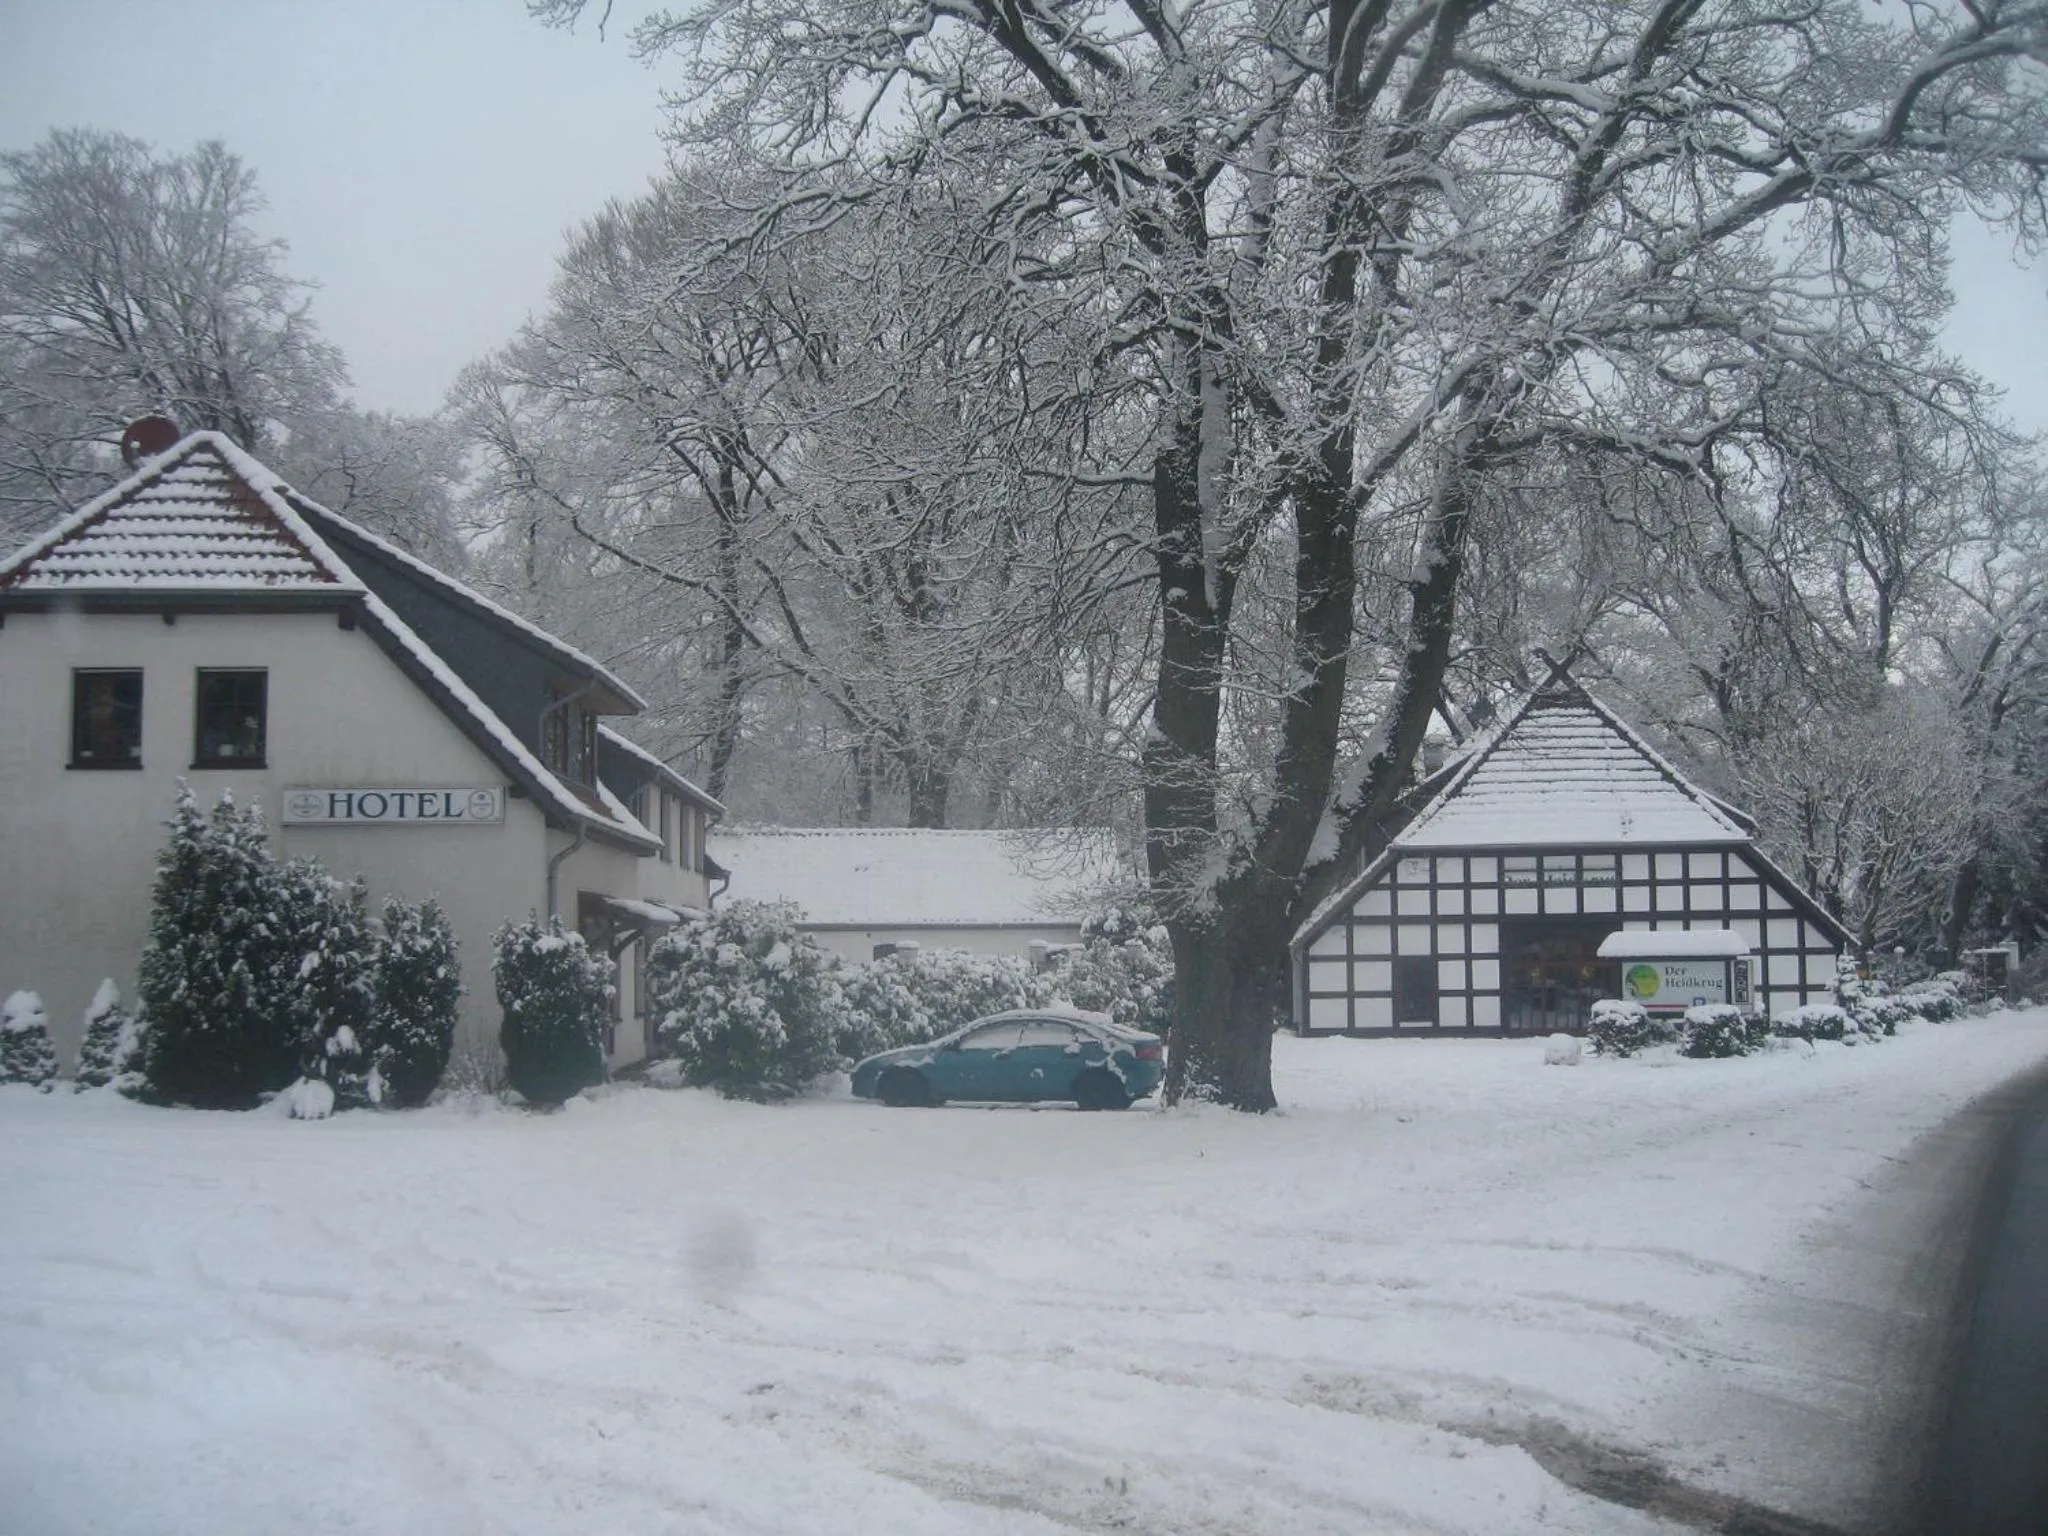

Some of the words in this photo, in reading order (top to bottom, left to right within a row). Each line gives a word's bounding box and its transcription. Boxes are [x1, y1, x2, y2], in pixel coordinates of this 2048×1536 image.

[328, 792, 465, 819] HOTEL
[1664, 966, 1686, 976] Der
[1664, 977, 1723, 989] Heidkrug
